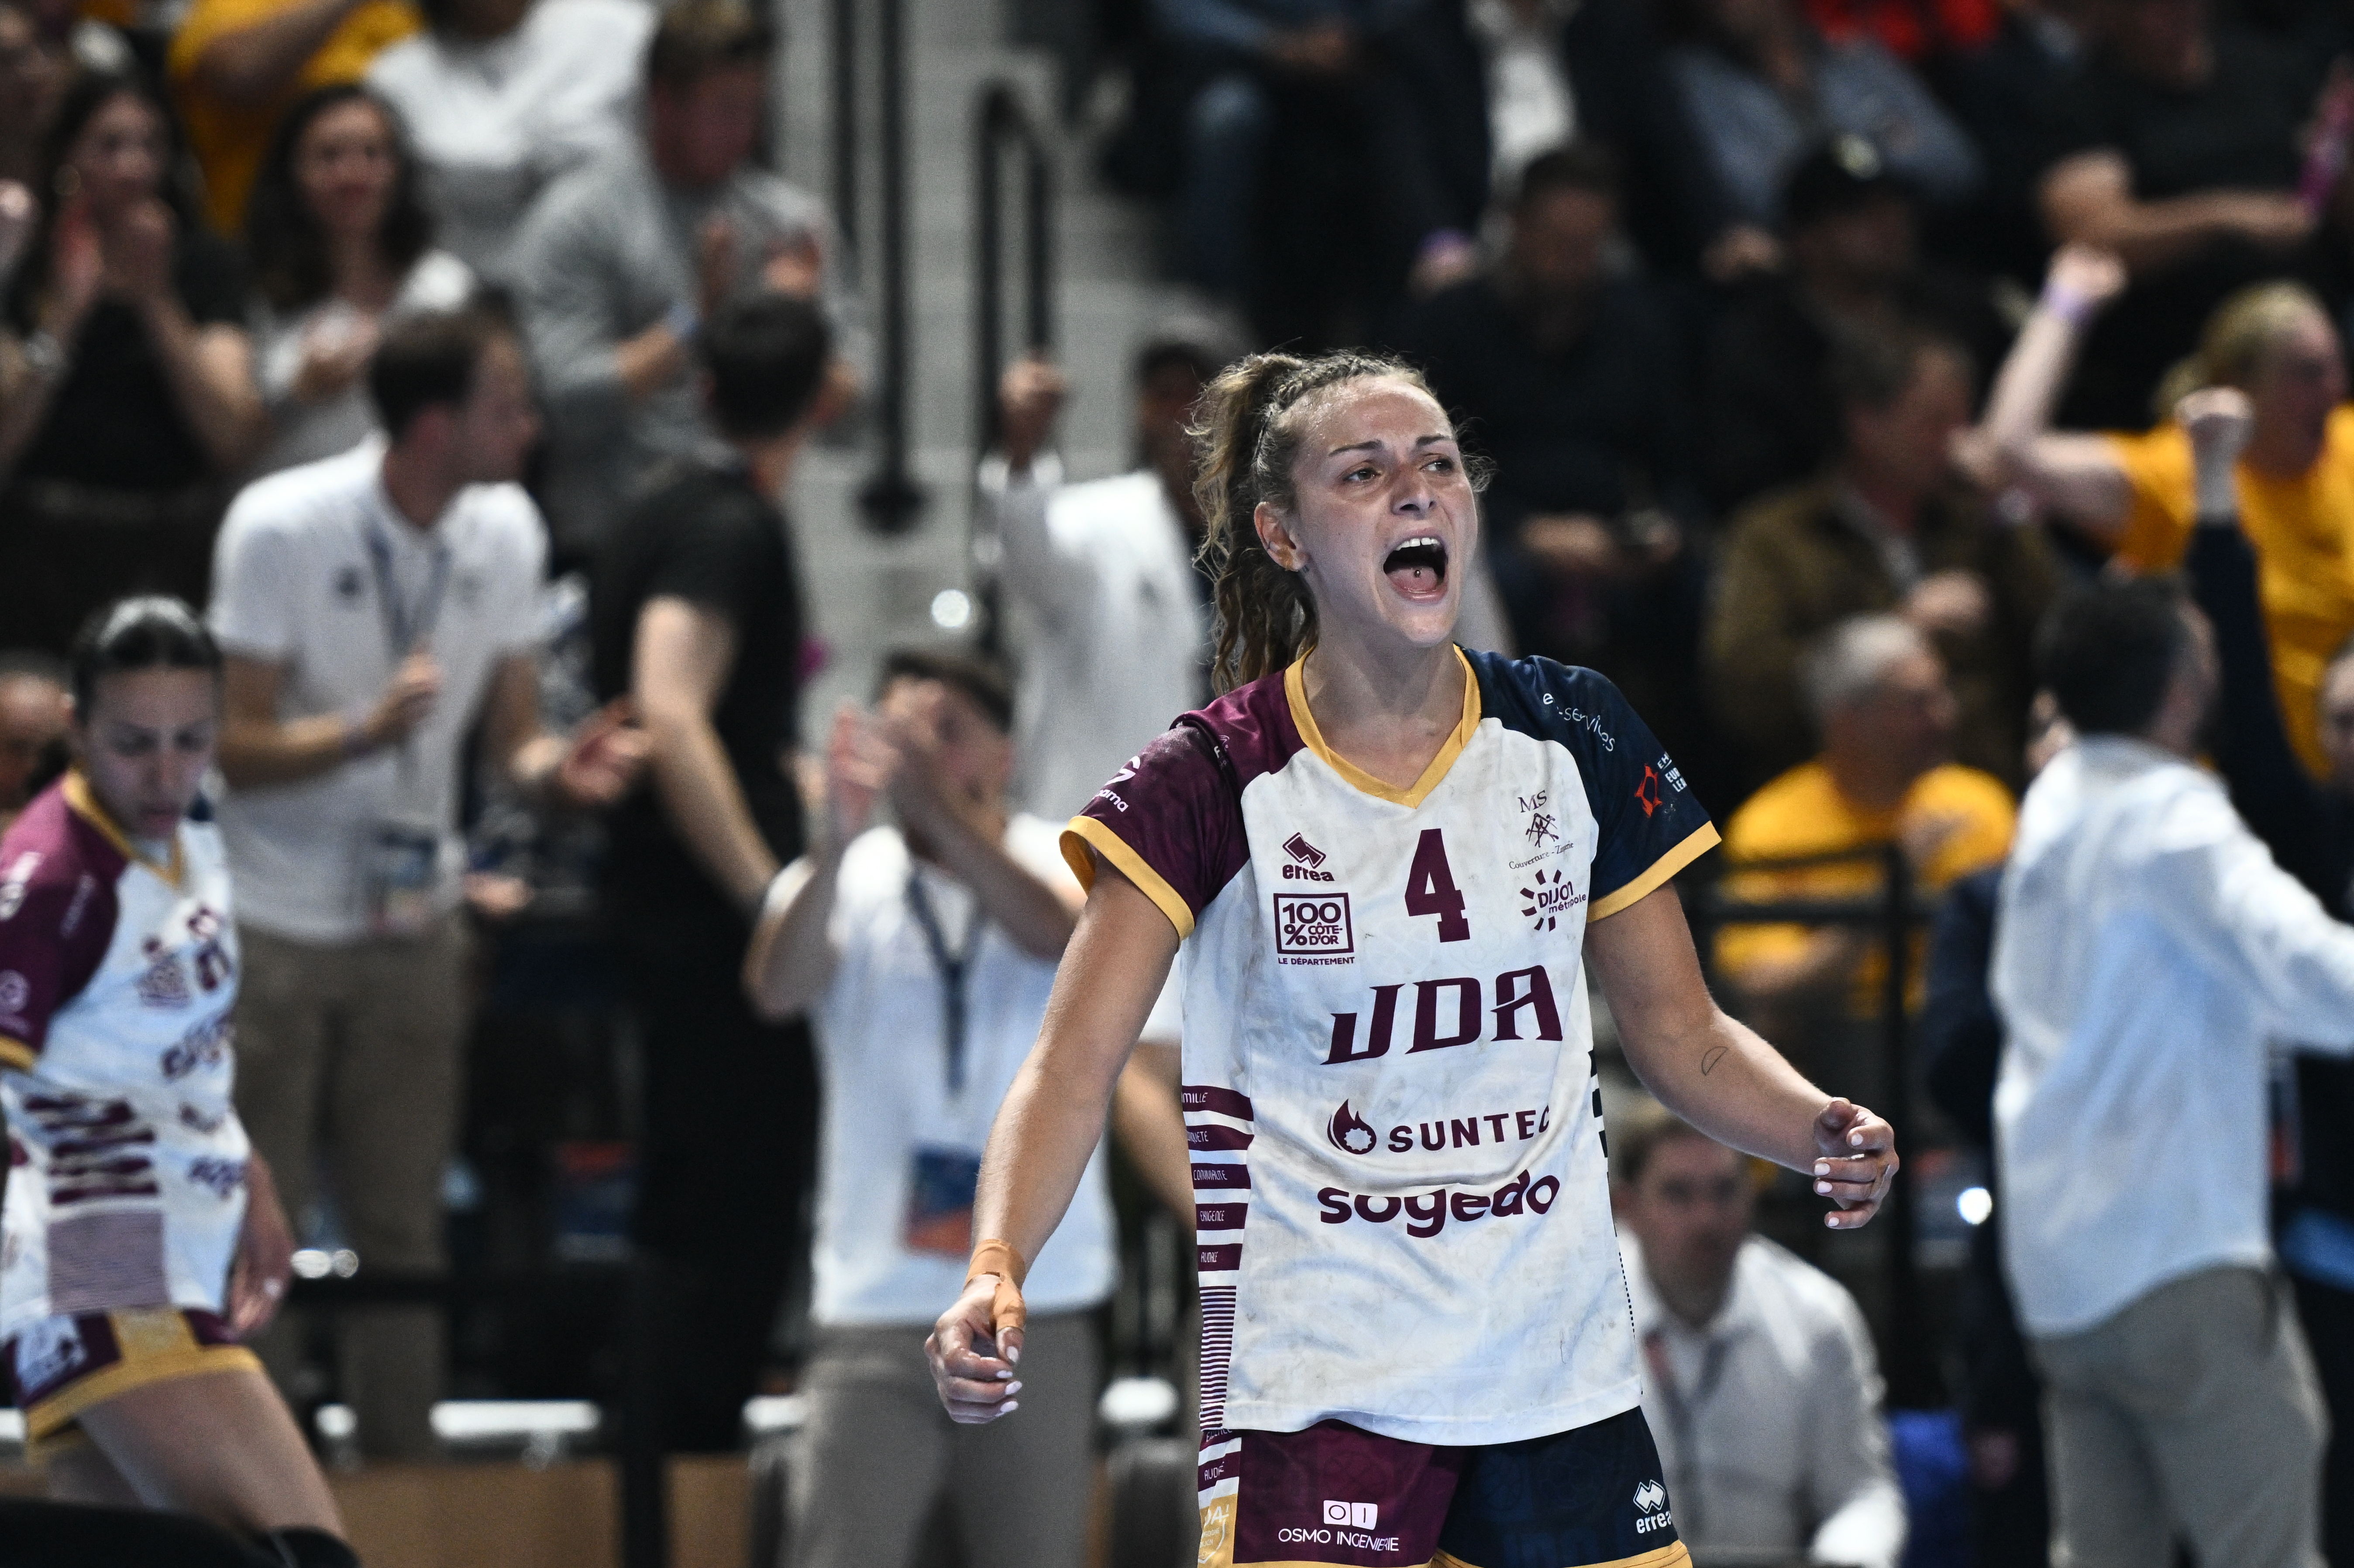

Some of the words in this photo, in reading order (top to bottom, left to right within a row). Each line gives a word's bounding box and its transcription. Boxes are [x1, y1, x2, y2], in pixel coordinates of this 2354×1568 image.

[1517, 789, 1547, 813] MS
[1282, 864, 1335, 882] errea
[1404, 828, 1470, 943] 4
[1283, 902, 1342, 924] 100
[1309, 933, 1339, 946] D'OR
[1291, 956, 1356, 966] DÉPARTEMENT
[1320, 965, 1563, 1065] JDA
[1317, 1169, 1560, 1239] sogedo
[1200, 1210, 1225, 1222] EXIGENCE
[1201, 1251, 1218, 1263] AUDACE
[1636, 1510, 1672, 1534] errea
[1278, 1528, 1331, 1544] OSMO
[1336, 1531, 1399, 1551] INGENIERIE
